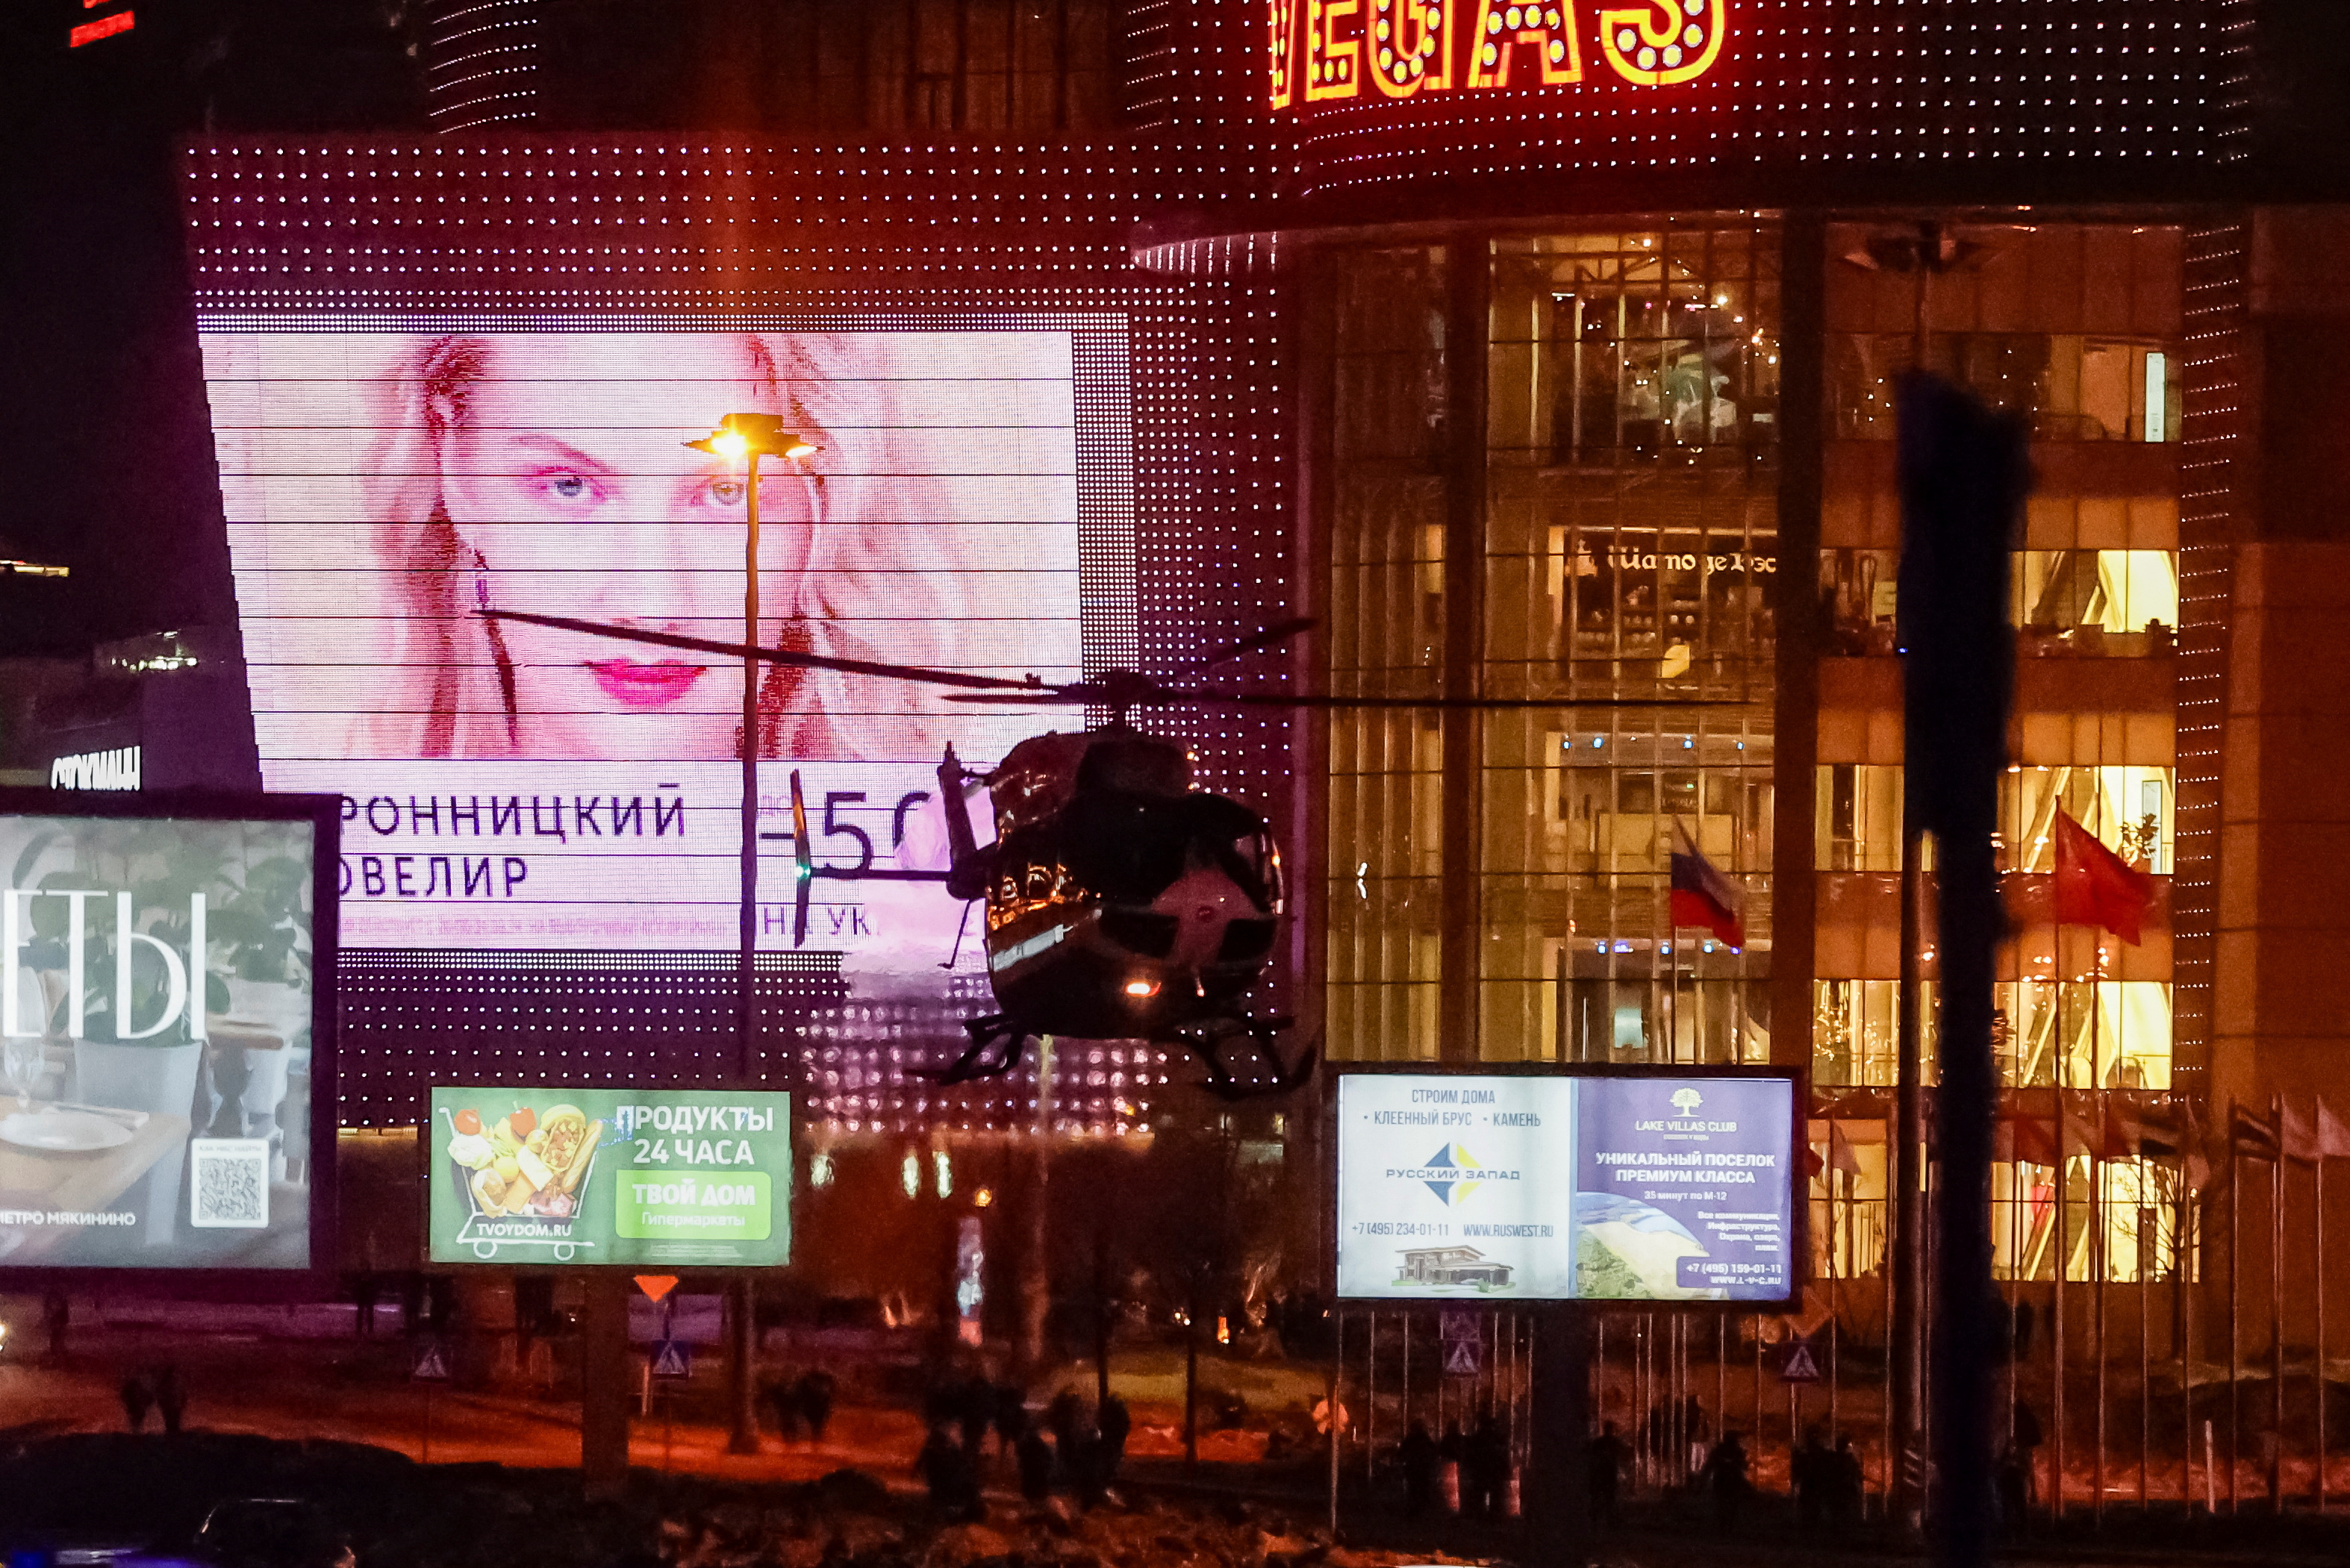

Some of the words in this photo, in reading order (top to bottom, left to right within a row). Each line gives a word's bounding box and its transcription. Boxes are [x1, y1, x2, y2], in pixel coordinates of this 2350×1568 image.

[1272, 0, 1725, 110] VEGAS
[1412, 1089, 1458, 1104] СТРОИМ
[1461, 1090, 1495, 1105] ДОМА
[615, 1105, 773, 1134] ПРОДУКТЫ
[1374, 1109, 1439, 1125] КЛЕЕННЫЙ
[1442, 1112, 1472, 1125] БРУС
[1493, 1113, 1542, 1127] КАМЕНЬ
[1635, 1121, 1664, 1131] LAKE
[1667, 1121, 1706, 1132] VILLAS
[1708, 1122, 1737, 1132] CLUB
[632, 1139, 670, 1164] 24
[674, 1140, 755, 1165] ЧАСА
[1596, 1151, 1702, 1166] УНИКАЛЬНЫЙ
[1704, 1154, 1775, 1167] ПОСЕЛОК
[1386, 1167, 1459, 1179] РУССКИЙ
[1465, 1169, 1521, 1180] ЗАПАД
[1615, 1169, 1692, 1183] ПРЕМИУМ
[1695, 1170, 1755, 1184] КЛАССА
[632, 1178, 696, 1206] ТВОЙ
[700, 1184, 756, 1207] ДОМ
[1644, 1190, 1656, 1200] 35
[1657, 1193, 1689, 1202] минут
[47, 1212, 136, 1226] МЯКИНИНО
[642, 1211, 746, 1228] Гипермаркеты
[476, 1223, 573, 1237] TVOYDOM.RU
[1352, 1222, 1365, 1235] +7
[1396, 1223, 1449, 1236] 234-01-11
[1463, 1224, 1554, 1237] WWW.RUSWEST.RU
